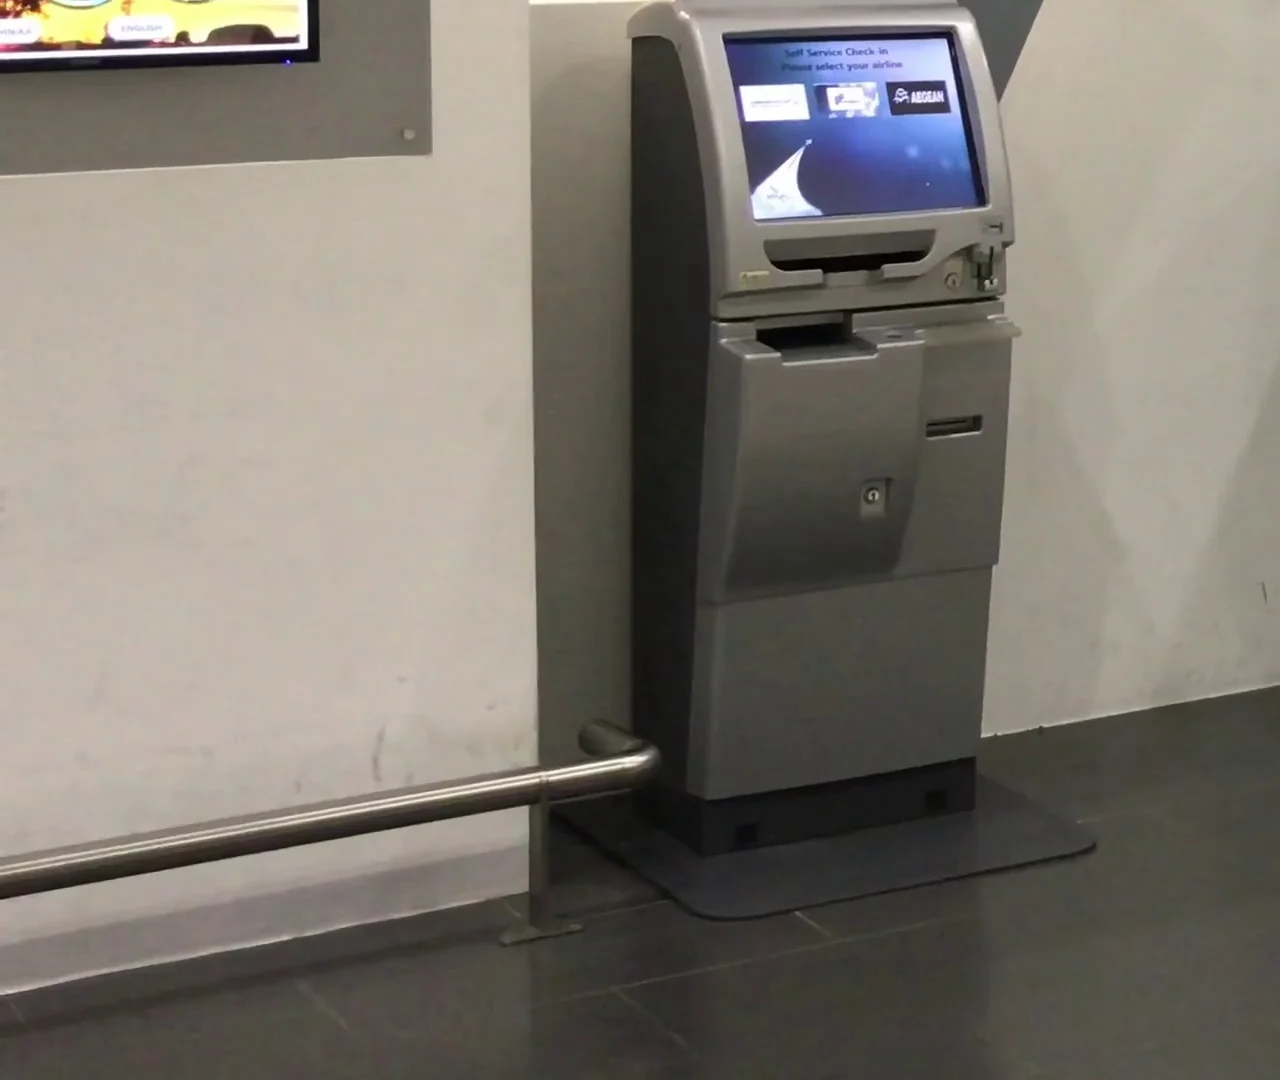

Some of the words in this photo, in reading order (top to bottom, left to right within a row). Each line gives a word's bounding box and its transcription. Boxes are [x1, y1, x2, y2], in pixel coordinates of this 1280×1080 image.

[784, 48, 804, 58] Self
[807, 48, 842, 57] Service
[845, 47, 875, 57] Check
[816, 61, 844, 71] select
[847, 61, 869, 72] your
[872, 60, 903, 69] airline
[910, 90, 945, 104] AEGEAN
